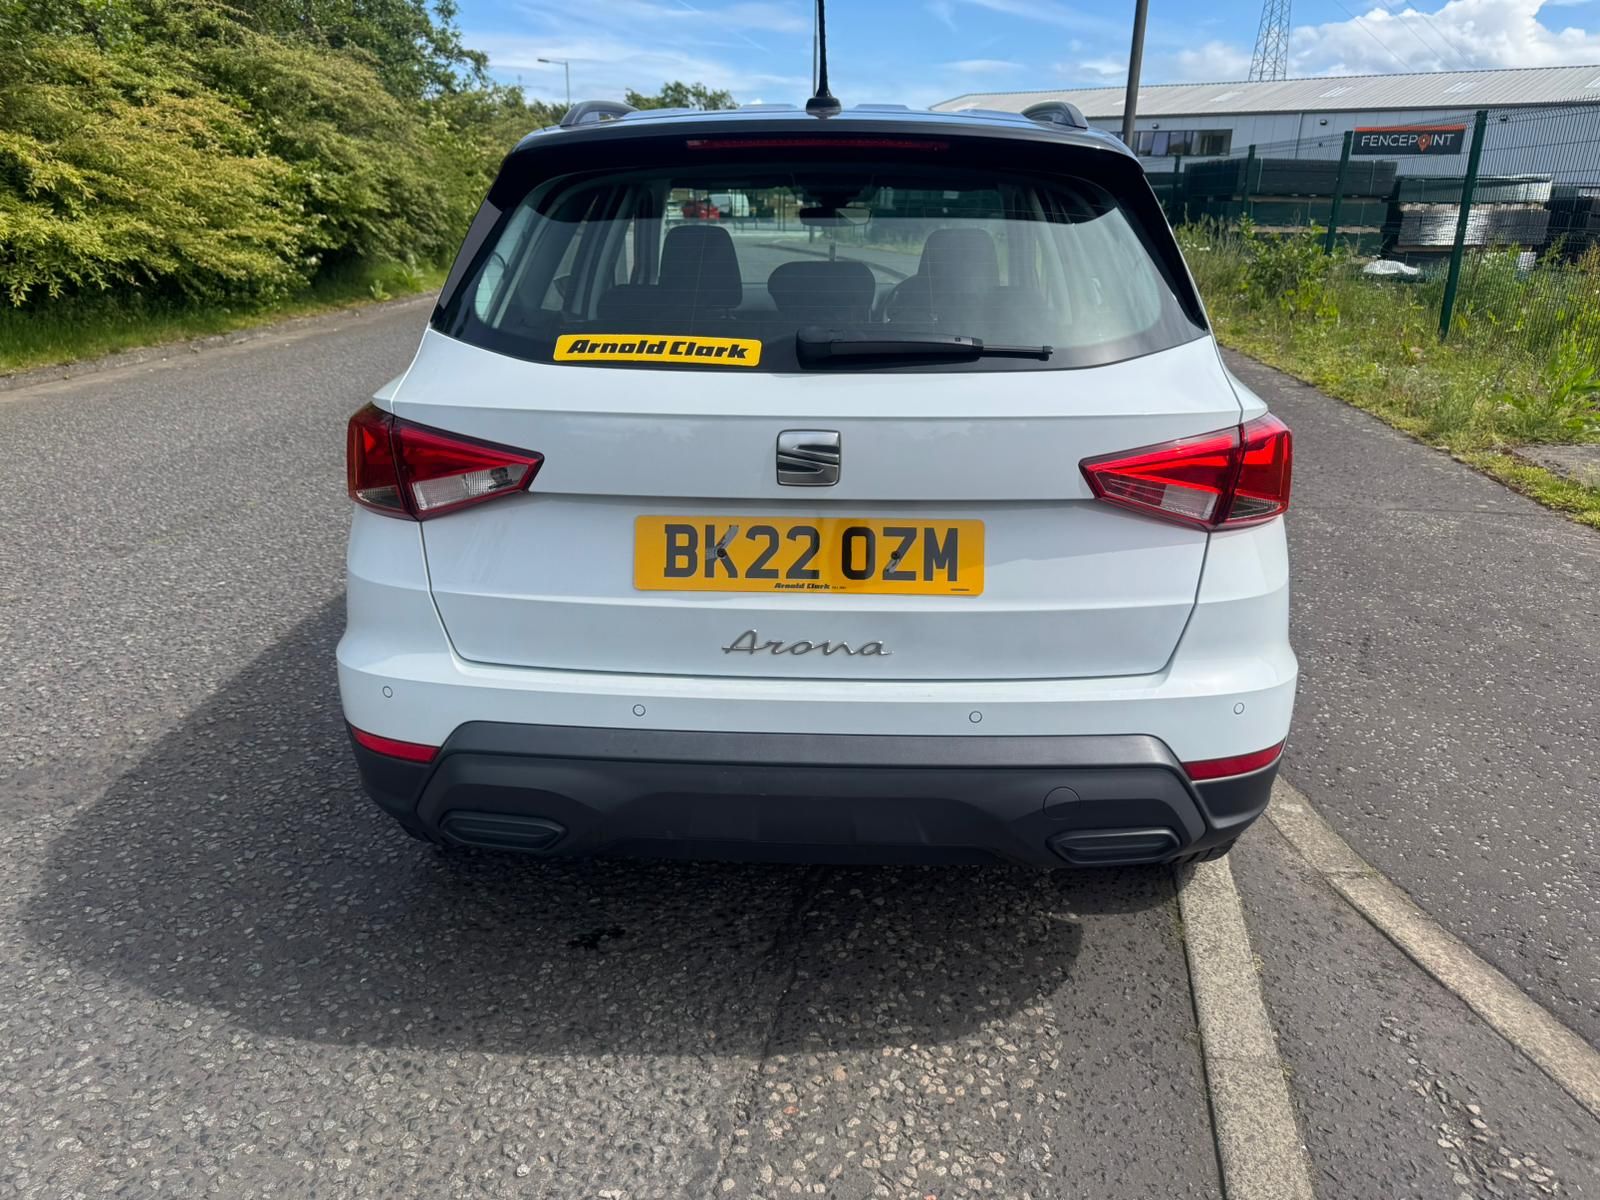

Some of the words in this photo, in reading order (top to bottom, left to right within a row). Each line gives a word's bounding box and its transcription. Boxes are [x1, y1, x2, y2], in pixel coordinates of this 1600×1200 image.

[1361, 134, 1455, 150] FENCEPOINT
[566, 339, 667, 355] Arnold
[668, 341, 749, 359] Clark
[663, 524, 820, 580] BK22
[722, 628, 895, 656] Arona
